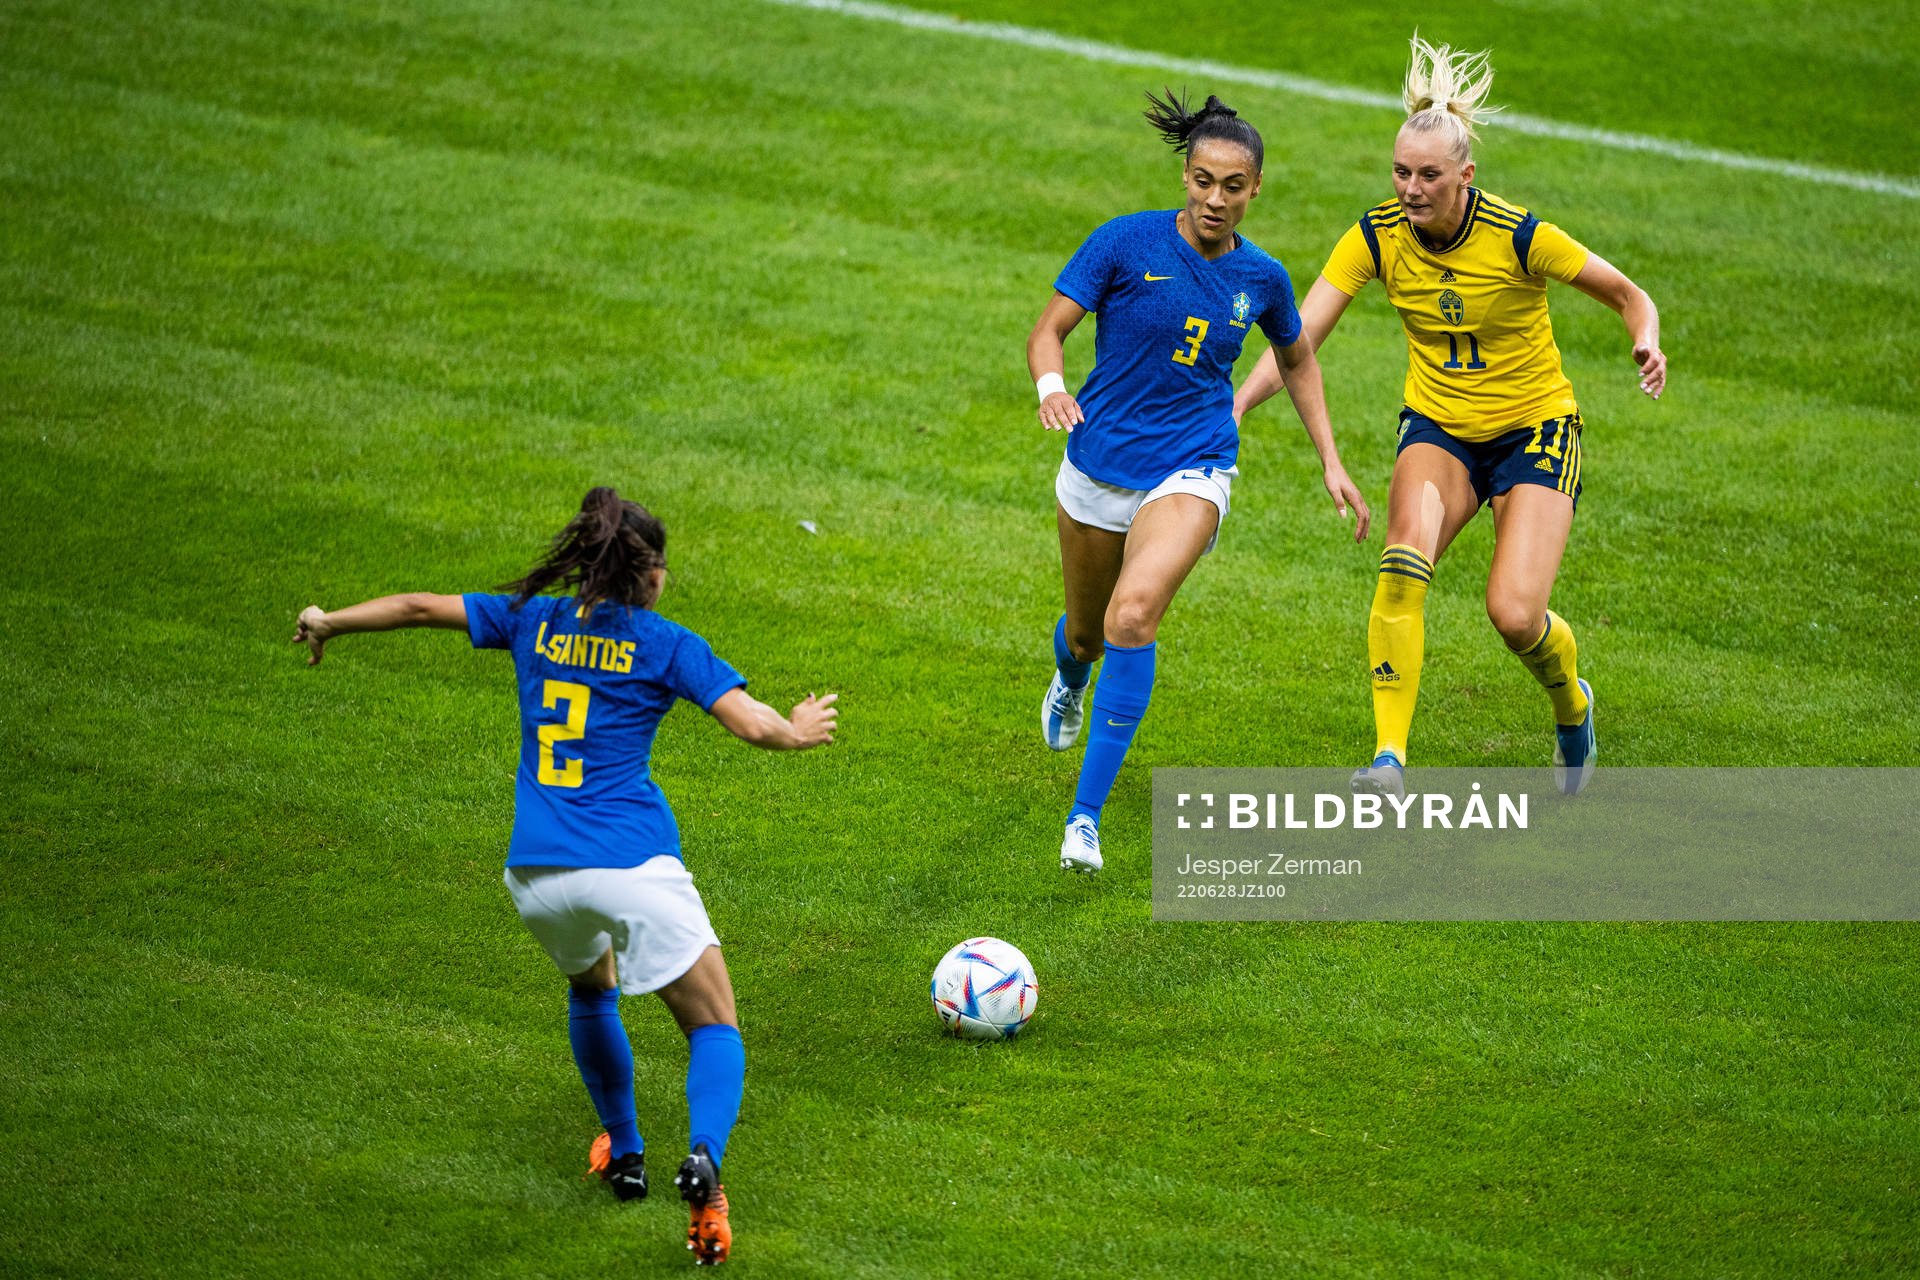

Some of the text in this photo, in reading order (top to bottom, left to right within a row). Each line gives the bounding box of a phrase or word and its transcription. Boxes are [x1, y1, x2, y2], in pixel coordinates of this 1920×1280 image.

[1171, 316, 1210, 366] 3
[1440, 331, 1487, 369] 11
[1524, 417, 1566, 459] 11
[1534, 463, 1554, 473] adidas
[537, 679, 591, 788] 2
